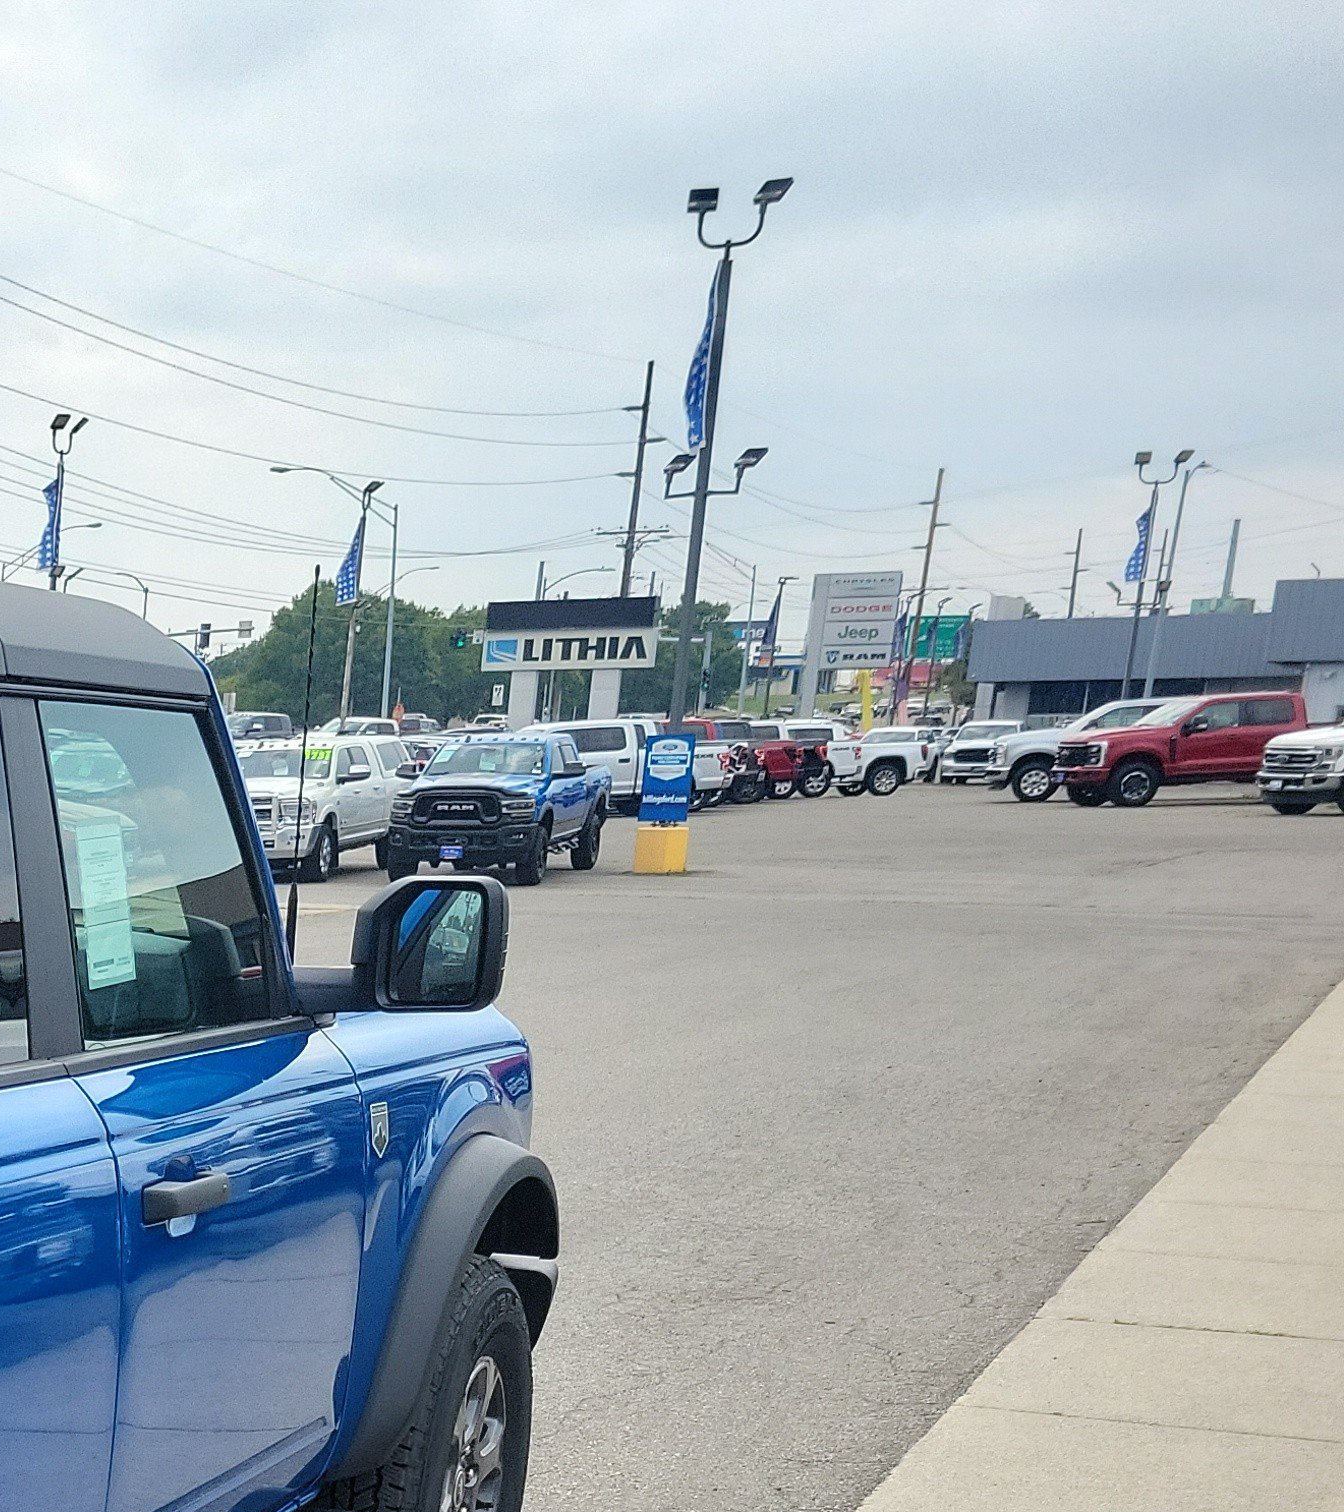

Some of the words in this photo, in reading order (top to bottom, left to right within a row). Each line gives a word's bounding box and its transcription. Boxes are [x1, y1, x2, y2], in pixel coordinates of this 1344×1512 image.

[830, 604, 893, 614] DODGE
[837, 625, 879, 641] Jeep
[522, 636, 647, 662] LITHIA
[842, 652, 887, 661] RAM
